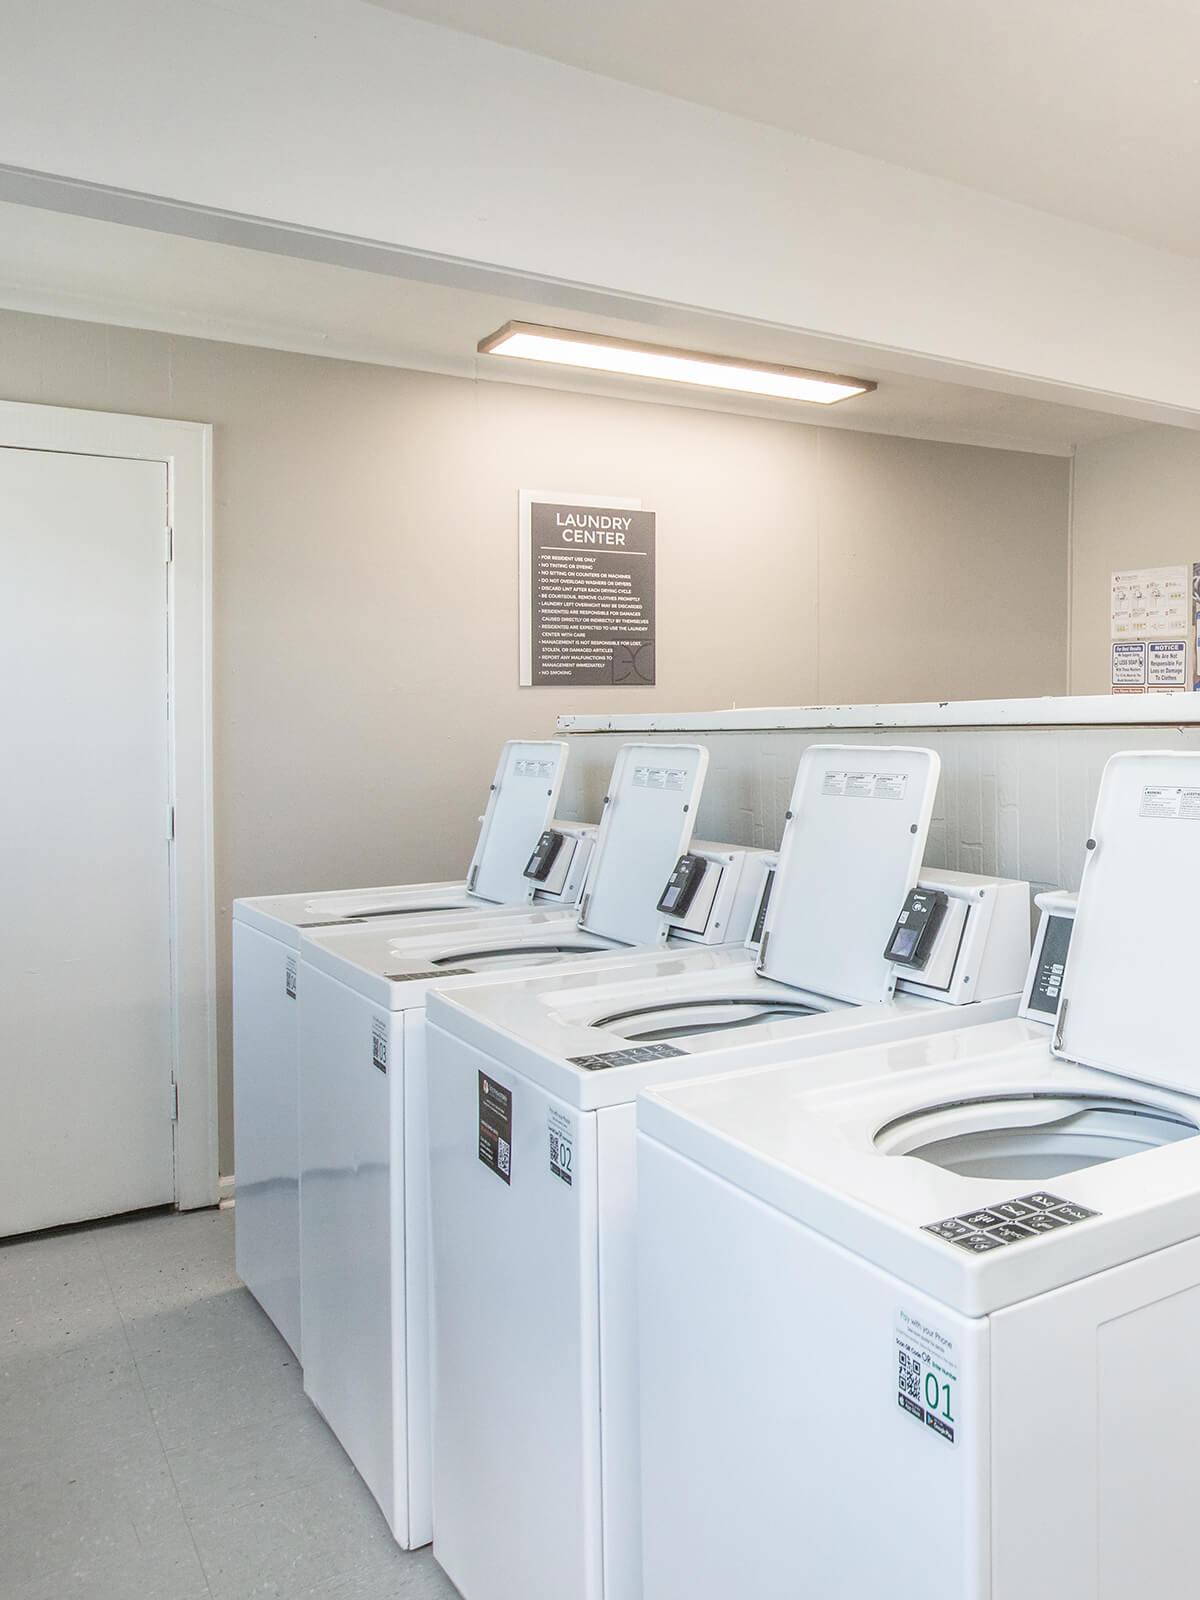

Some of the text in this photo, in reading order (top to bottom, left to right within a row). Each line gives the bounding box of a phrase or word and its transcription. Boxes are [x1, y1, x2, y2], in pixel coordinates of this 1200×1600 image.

[556, 513, 632, 530] LAUNDRY
[562, 530, 625, 545] CENTER
[560, 1143, 572, 1172] 02
[911, 1318, 921, 1329] with
[923, 1327, 934, 1337] your
[935, 1332, 953, 1349] Phone
[921, 1351, 931, 1363] OR
[925, 1372, 955, 1422] 01
